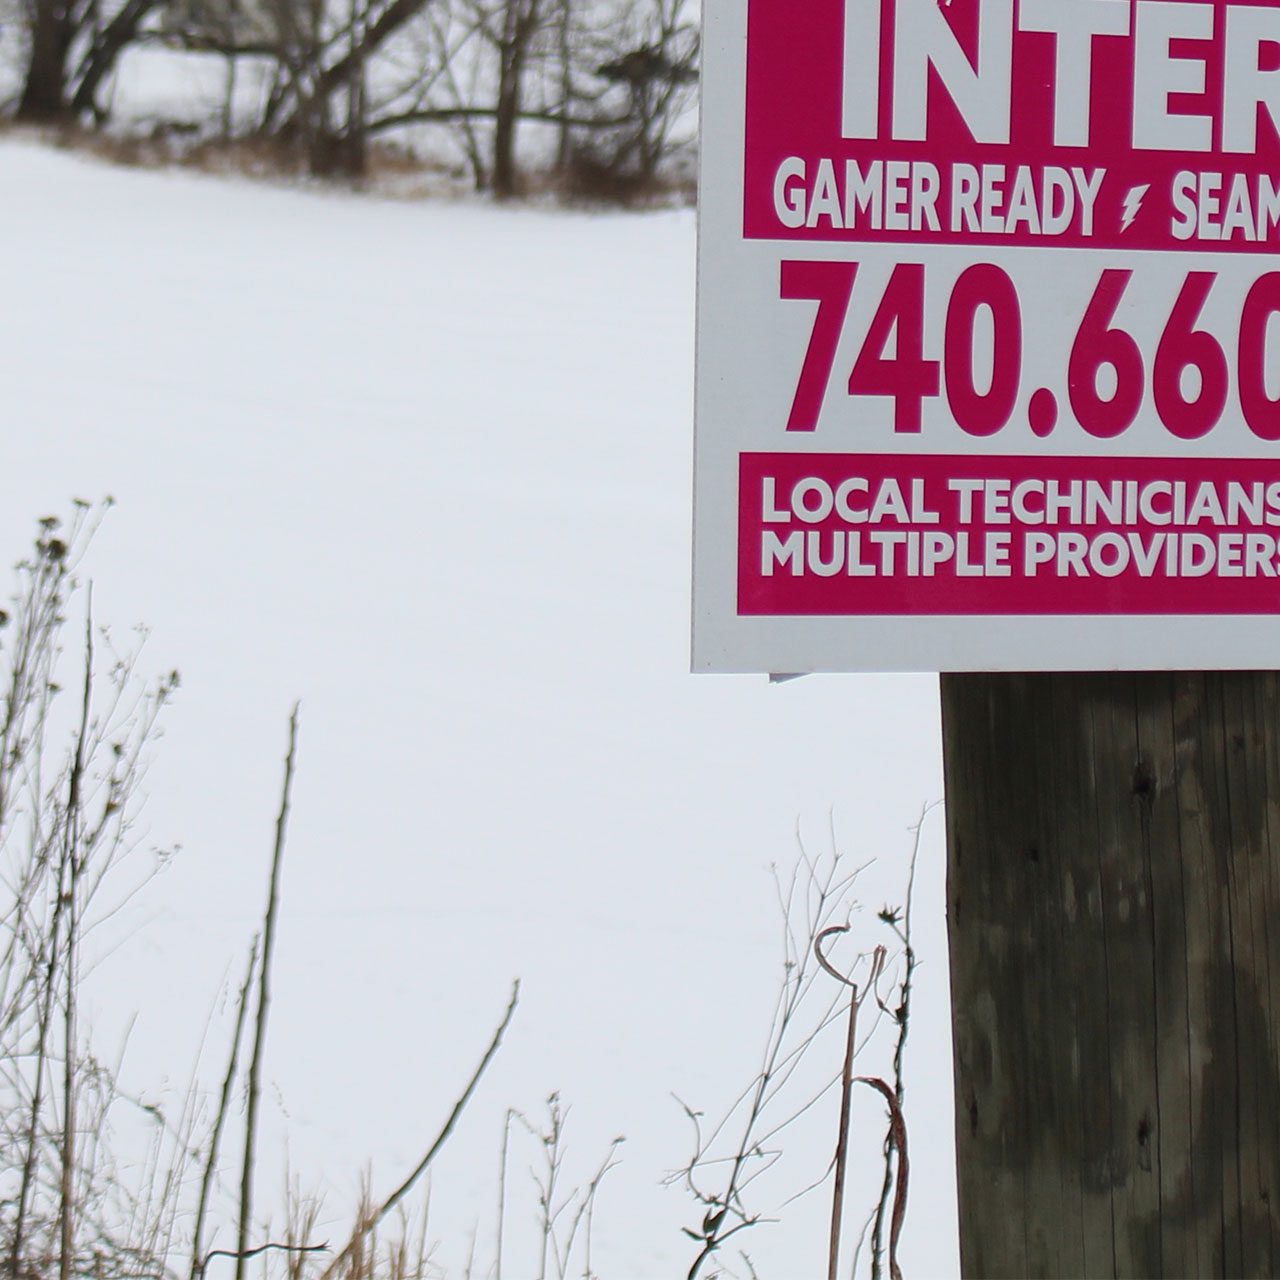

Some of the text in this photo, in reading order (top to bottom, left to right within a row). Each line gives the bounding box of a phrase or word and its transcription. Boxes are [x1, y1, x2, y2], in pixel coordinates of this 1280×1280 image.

[773, 155, 942, 232] GAMER
[950, 162, 1107, 236] READY
[761, 476, 940, 524] LOCAL
[761, 530, 1012, 577] MULTIPLE
